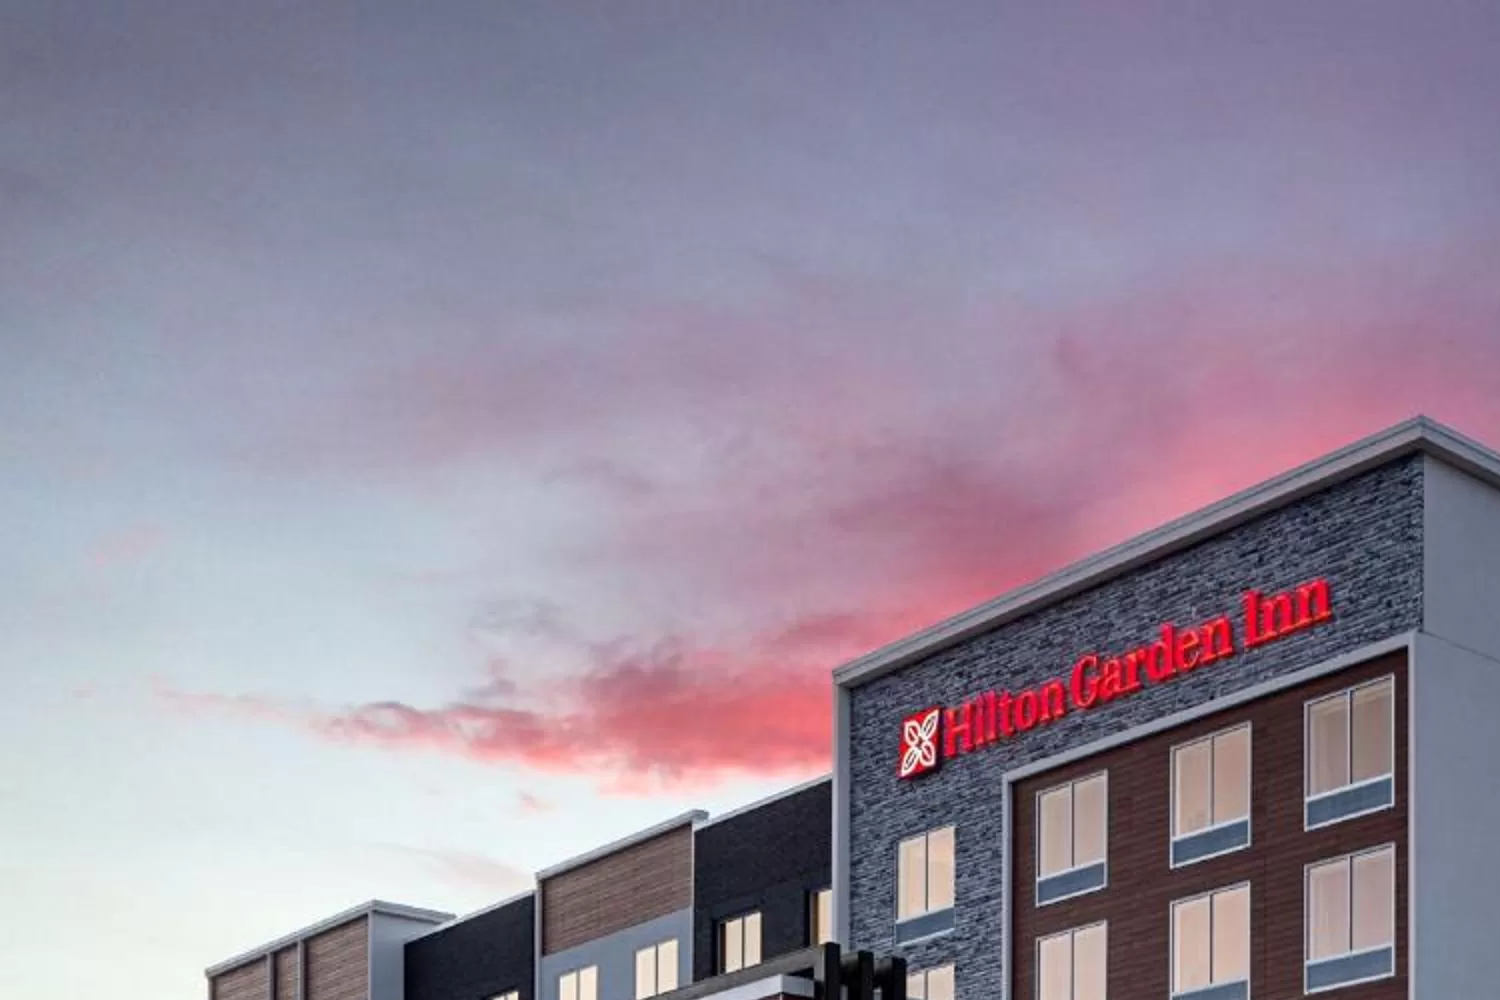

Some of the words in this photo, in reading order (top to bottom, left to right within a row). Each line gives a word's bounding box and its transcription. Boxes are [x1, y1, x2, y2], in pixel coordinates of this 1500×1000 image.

[943, 681, 1065, 758] Hilton
[1070, 615, 1233, 709] Garden
[1243, 578, 1332, 648] Inn
